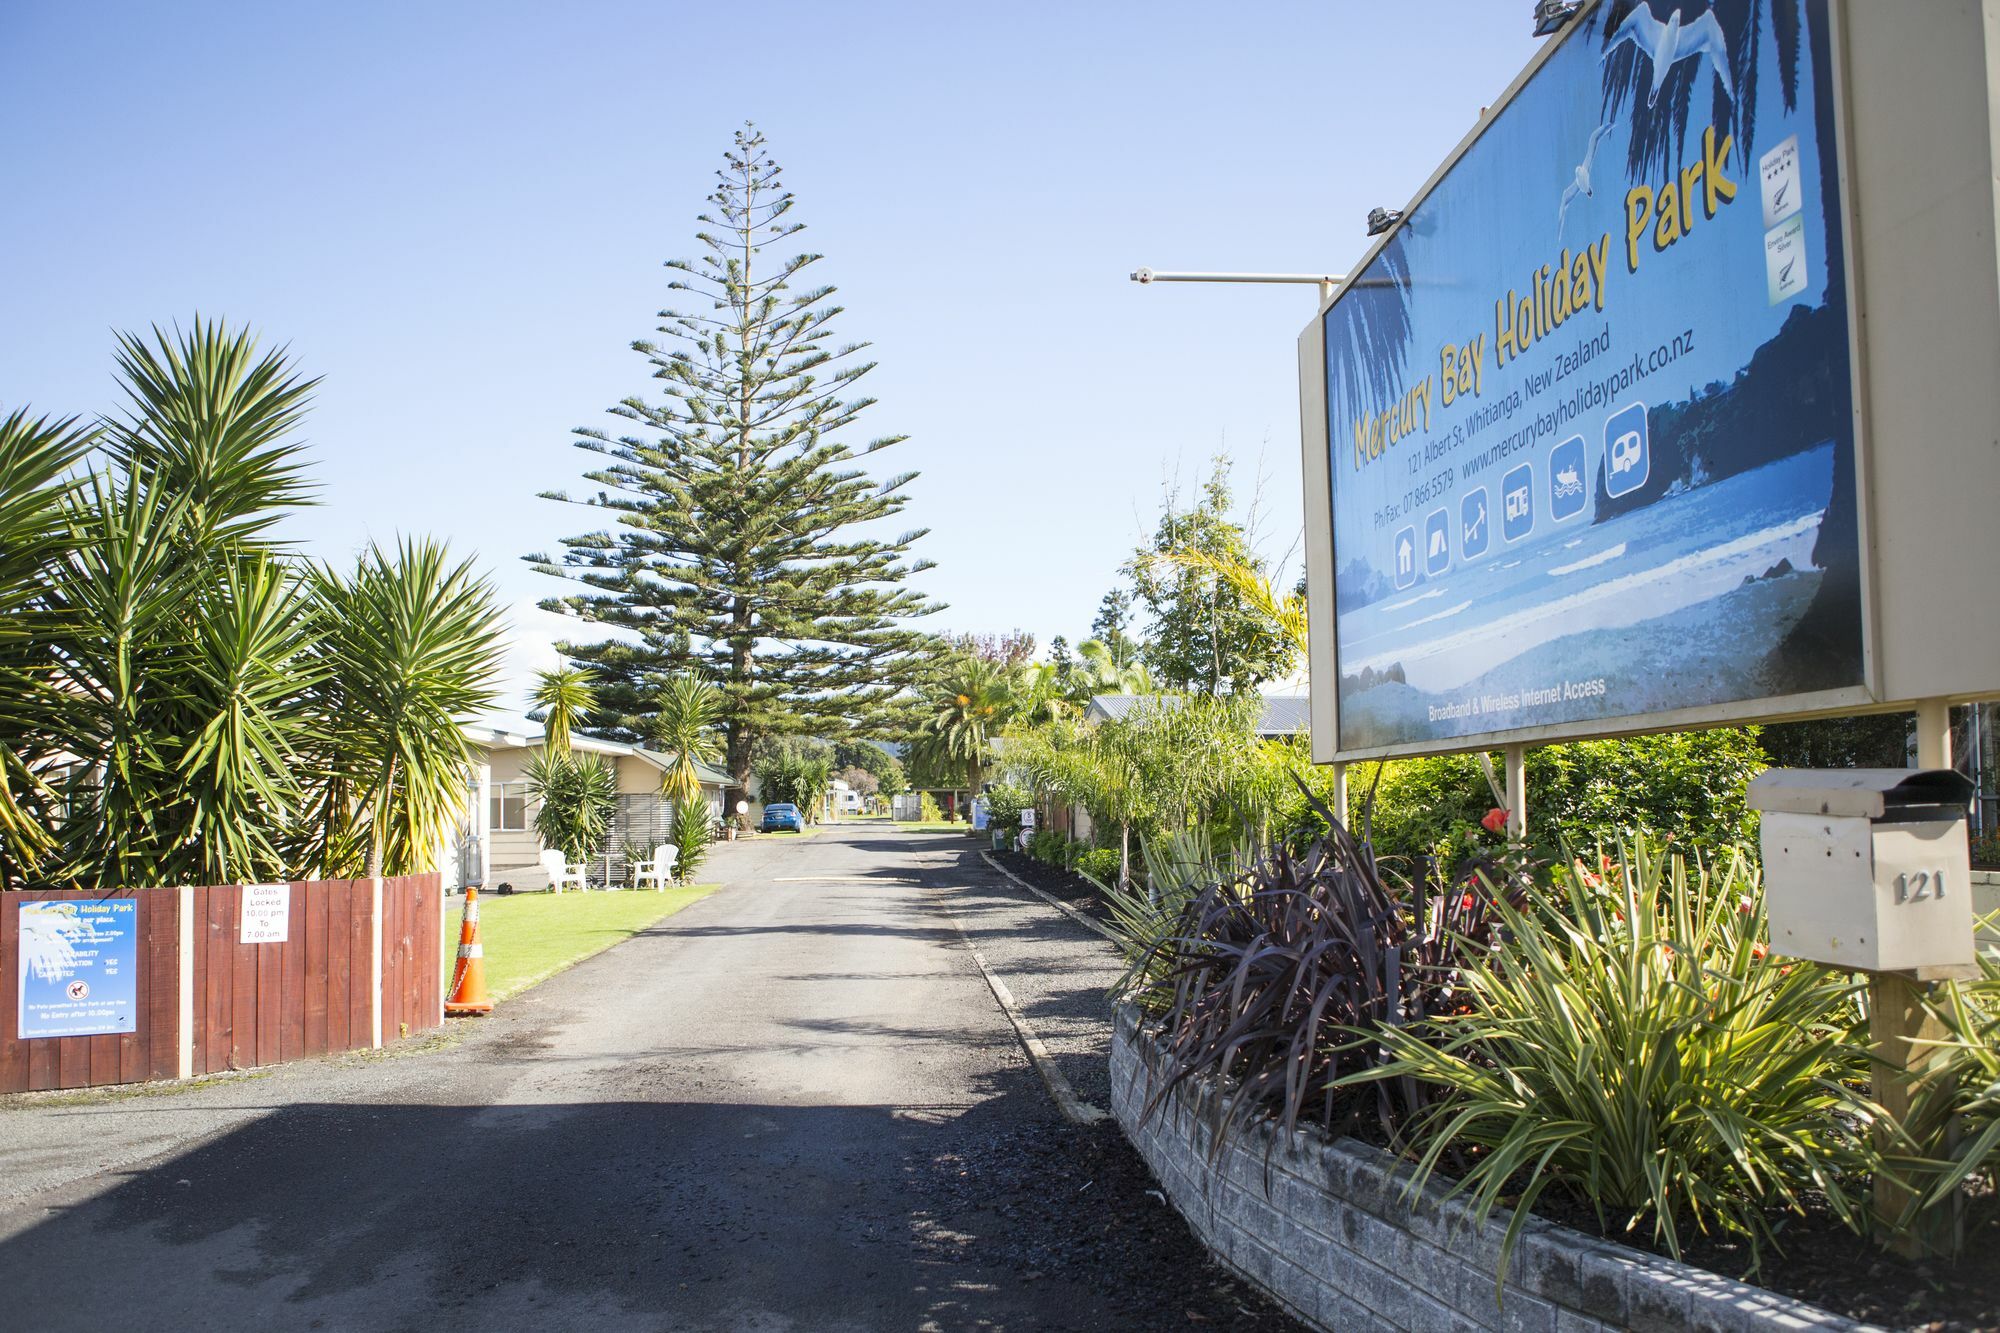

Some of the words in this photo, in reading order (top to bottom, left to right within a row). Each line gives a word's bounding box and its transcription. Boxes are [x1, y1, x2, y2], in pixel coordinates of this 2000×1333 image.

[1762, 153, 1781, 172] Holiday
[1782, 145, 1795, 158] Park
[1767, 236, 1783, 250] Enviro
[1784, 223, 1801, 239] Award
[1777, 240, 1791, 253] Silver
[1353, 374, 1433, 471] Mercury
[1439, 332, 1486, 408] Bay
[1495, 232, 1611, 370] Holiday
[1625, 125, 1737, 274] Park
[1408, 452, 1422, 476] 121
[1424, 434, 1451, 468] Albert
[1452, 424, 1465, 450] St,
[1465, 389, 1523, 440] Whitianga,
[1525, 366, 1552, 401] New
[1555, 322, 1610, 383] Zealand
[1374, 503, 1400, 531] Ph/Fax:
[1403, 490, 1413, 514] 07
[1415, 481, 1431, 508] 866
[1432, 467, 1454, 498] 5579
[1462, 328, 1694, 480] www.mercurybayholidaypark.co.nz
[1429, 699, 1471, 722] Broadband
[1472, 697, 1479, 714] &
[1480, 694, 1520, 713] Wireless
[1521, 685, 1561, 707] Internet
[1562, 677, 1606, 700] Access
[1897, 869, 1946, 902] 121
[63, 906, 78, 915] Bay
[81, 905, 111, 914] Holiday
[113, 904, 133, 912] Park
